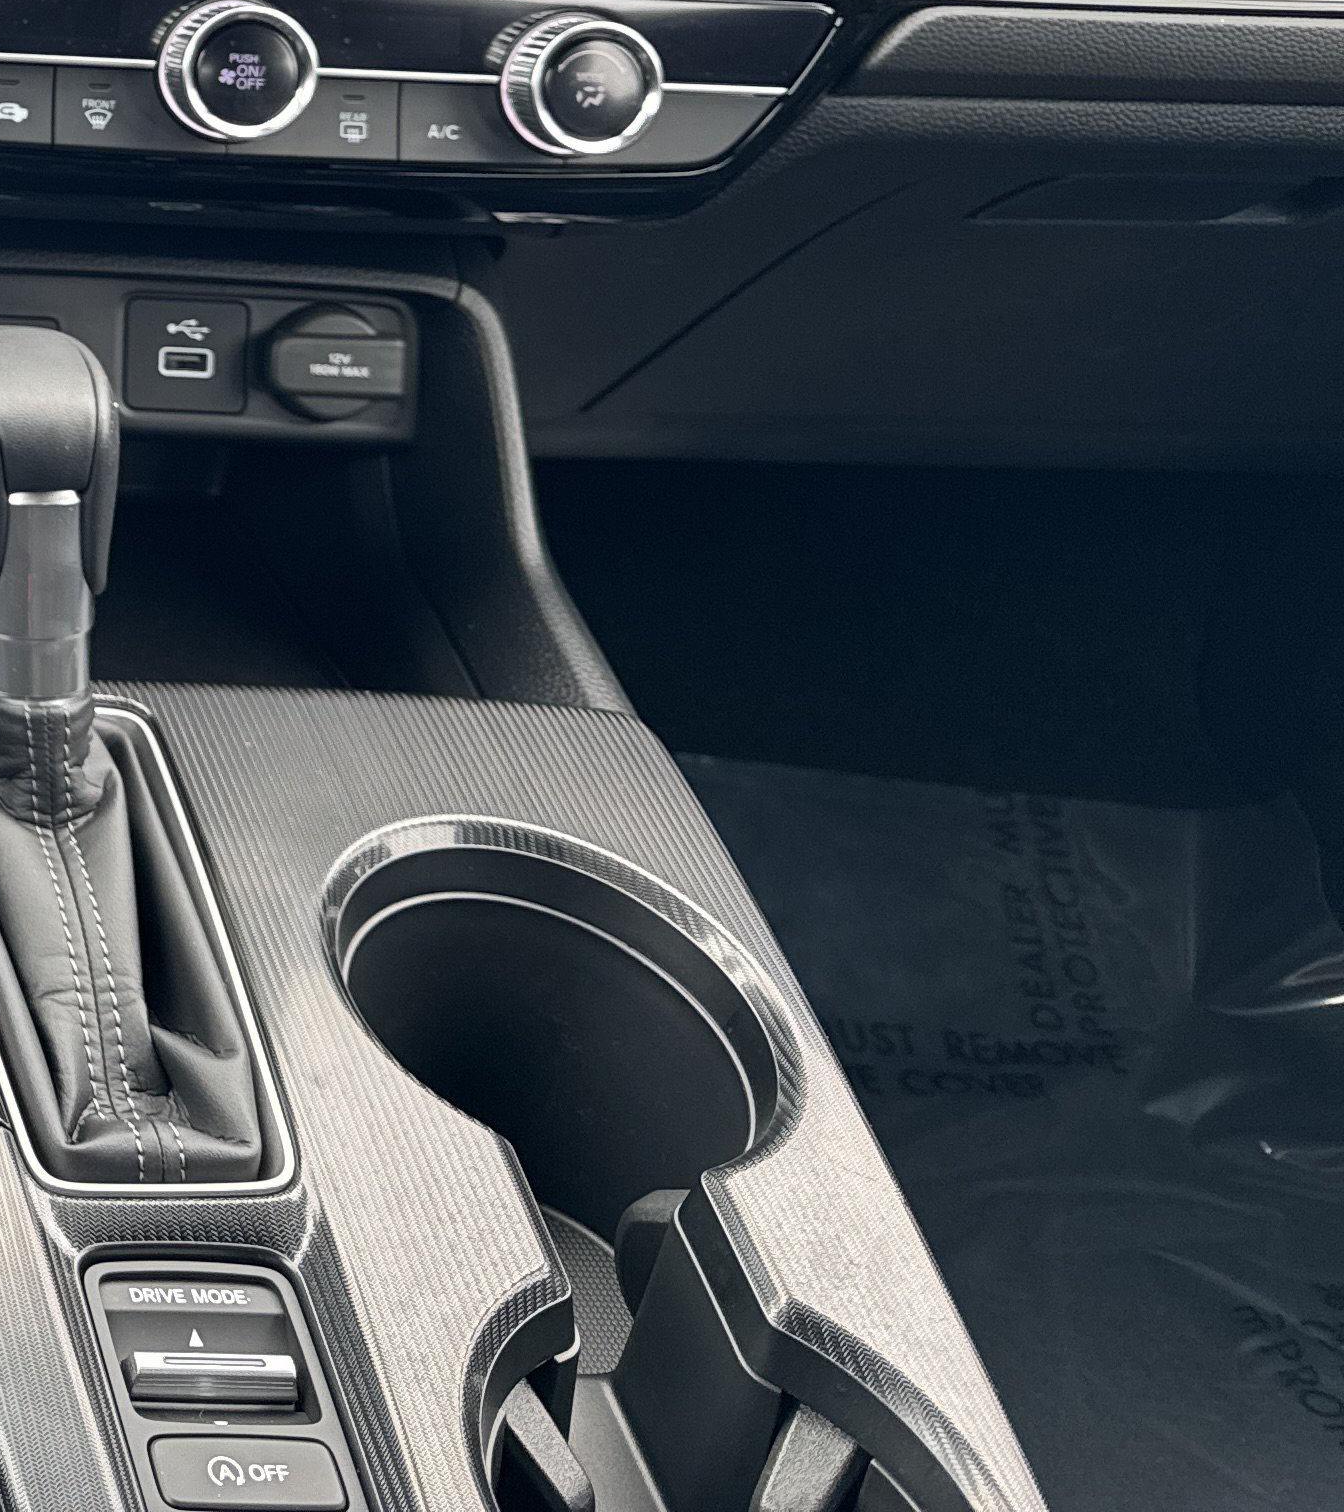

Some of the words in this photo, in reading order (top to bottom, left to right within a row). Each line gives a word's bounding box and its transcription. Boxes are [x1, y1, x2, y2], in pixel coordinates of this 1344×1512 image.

[228, 53, 260, 64] PUSH
[236, 65, 266, 78] ON/
[235, 77, 265, 91] OFF
[81, 98, 116, 110] FRONT
[339, 111, 367, 122] REAR
[427, 124, 463, 141] A/C
[128, 1287, 185, 1304] DRIVE
[191, 1289, 248, 1305] MODE
[248, 1464, 290, 1483] OFF
